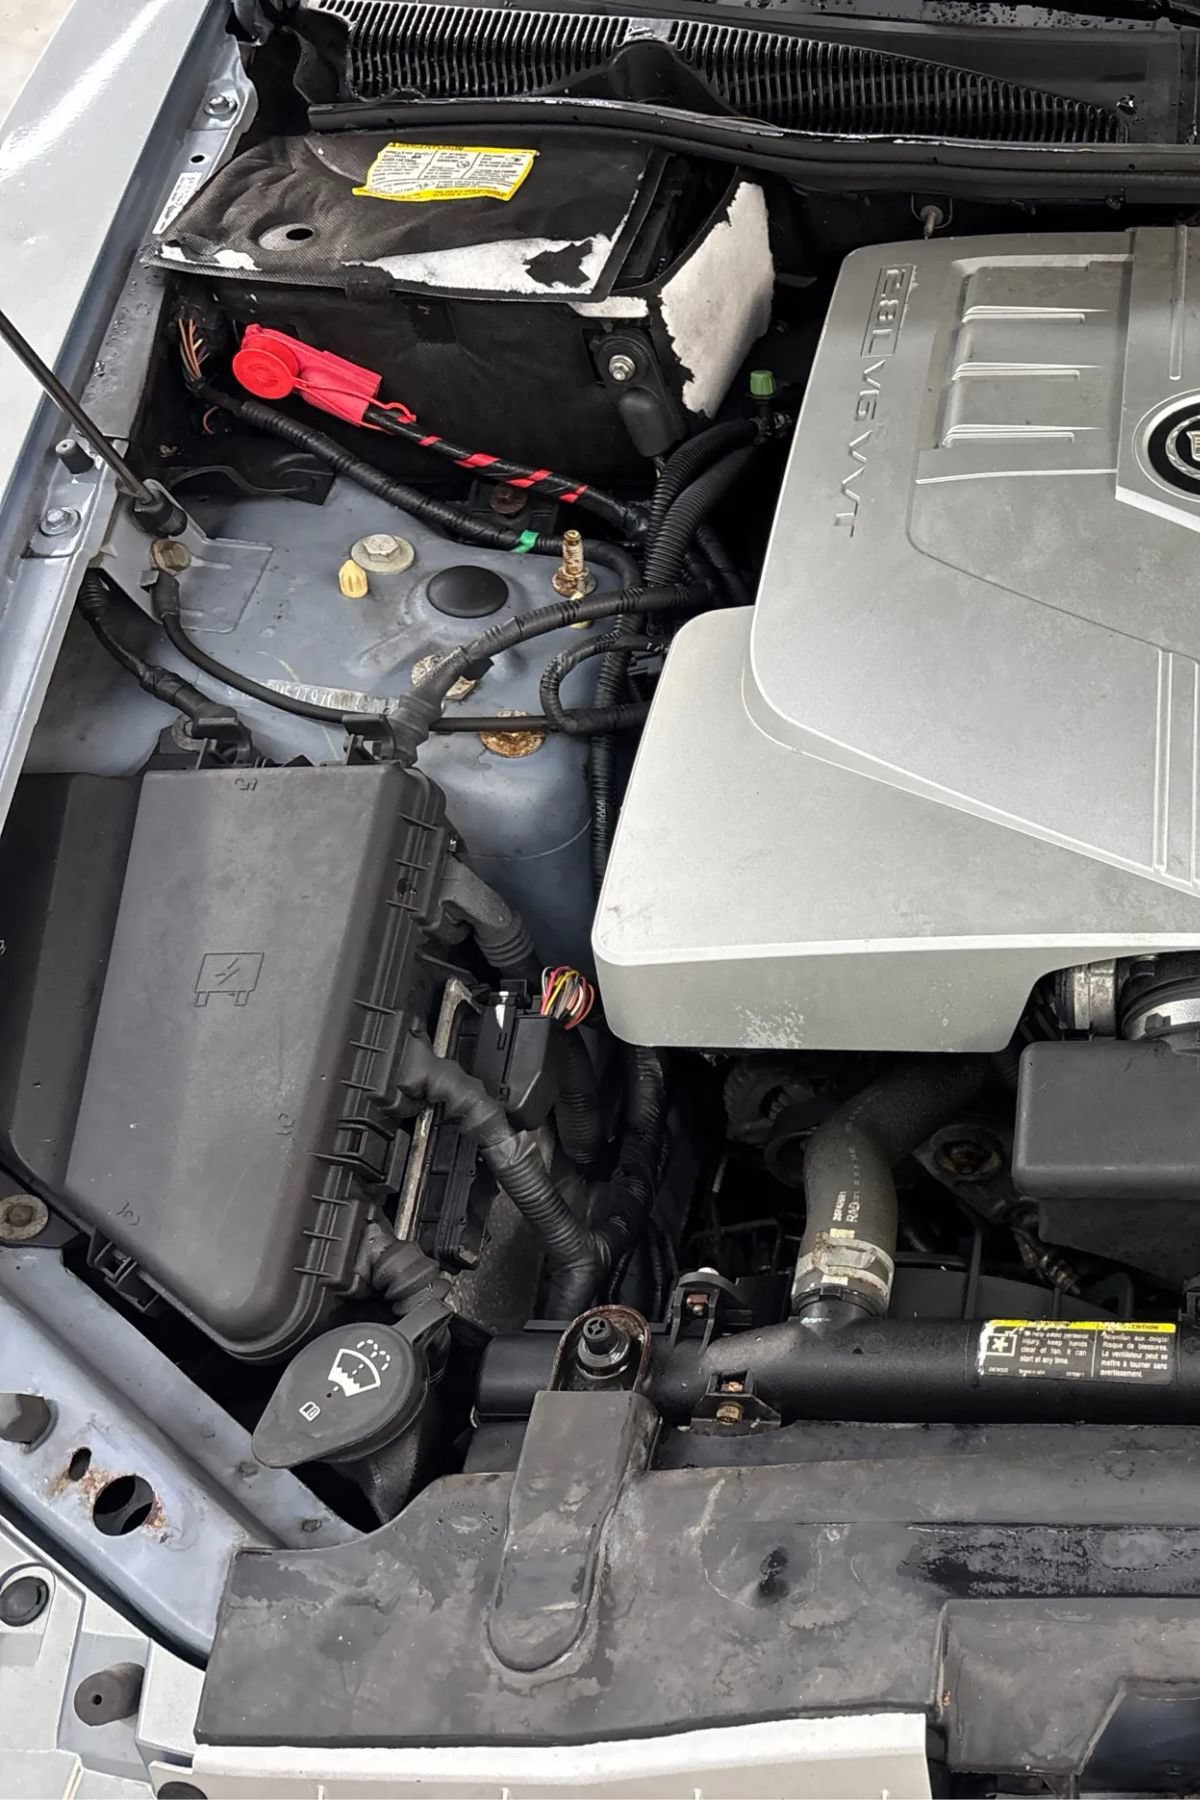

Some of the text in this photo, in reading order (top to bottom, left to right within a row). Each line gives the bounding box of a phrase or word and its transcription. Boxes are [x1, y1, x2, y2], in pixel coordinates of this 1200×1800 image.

[834, 269, 905, 538] 2.8L V6 VVT
